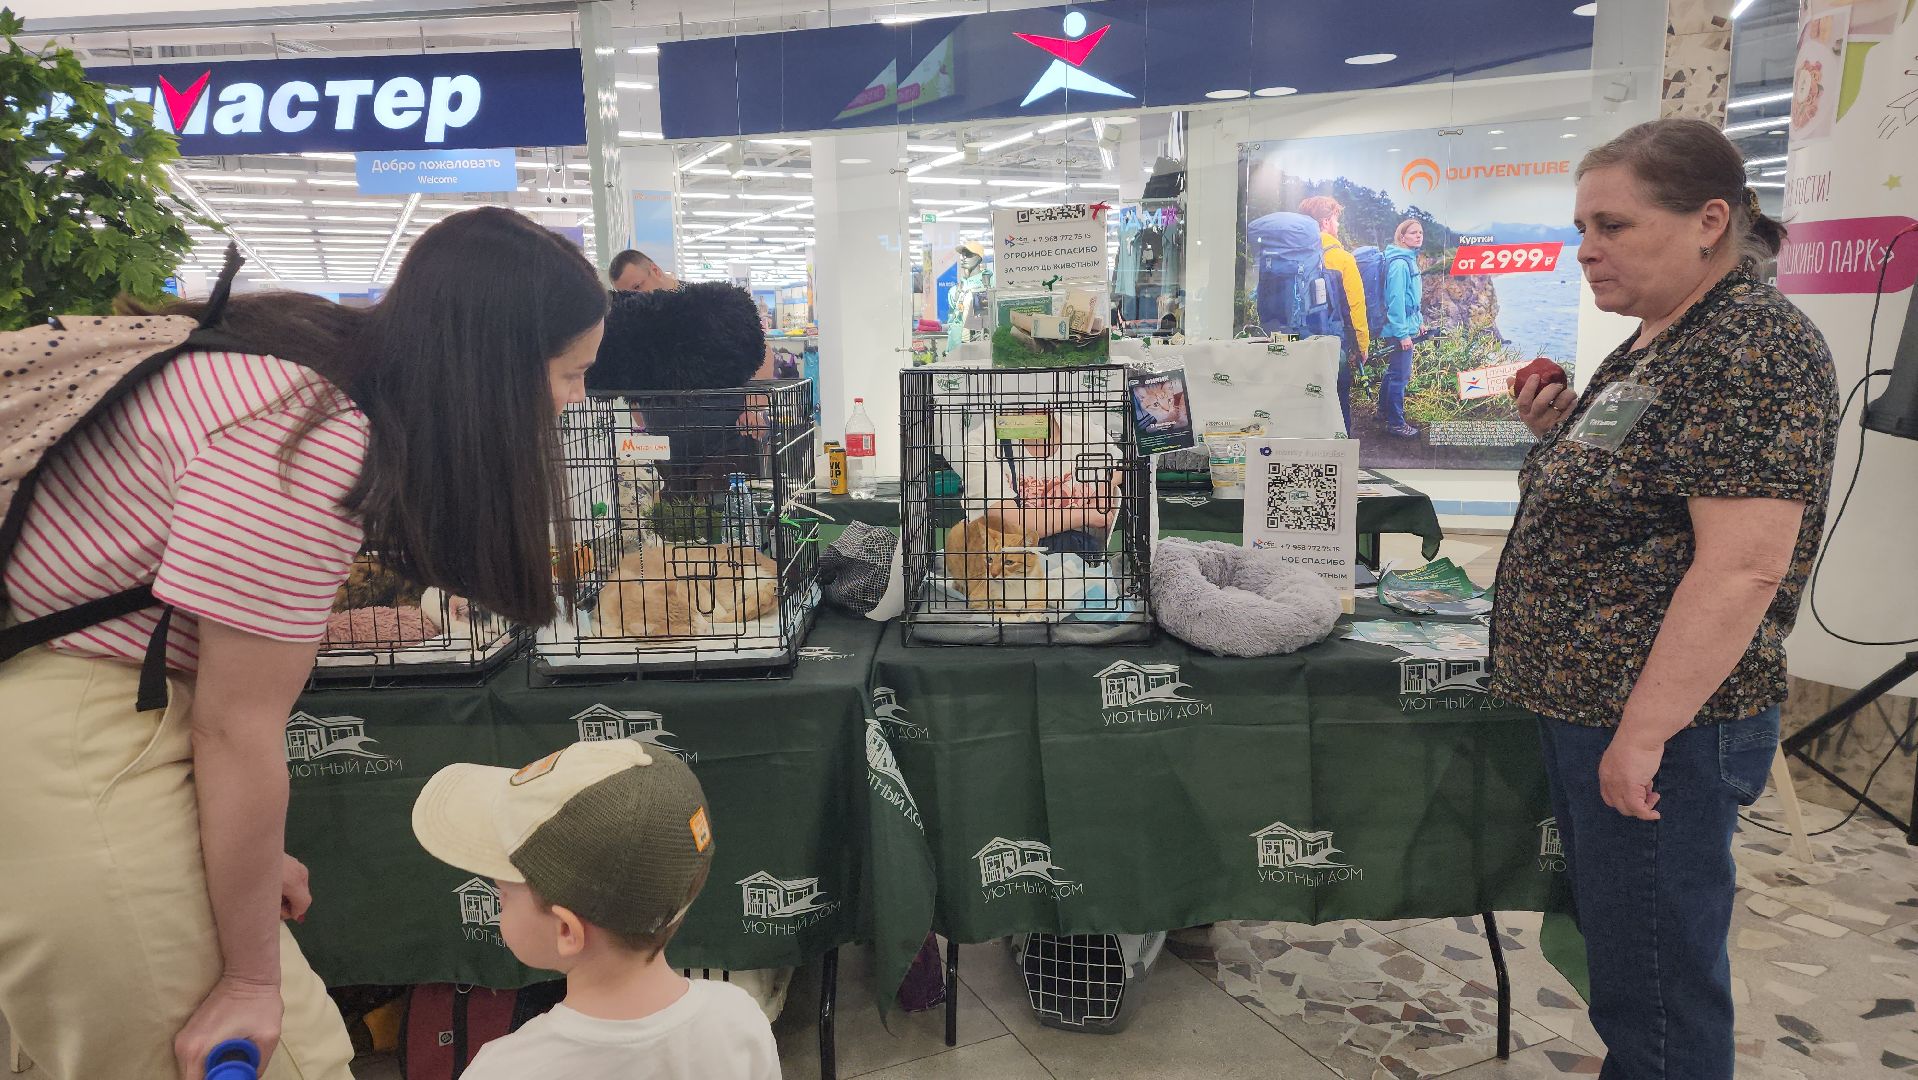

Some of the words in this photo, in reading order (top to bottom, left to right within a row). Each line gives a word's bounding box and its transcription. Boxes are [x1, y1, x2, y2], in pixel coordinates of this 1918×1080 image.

[371, 158, 416, 173] Добро
[419, 158, 501, 170] пожаловать
[1446, 160, 1571, 180] OUTVENTURE
[417, 175, 458, 184] Welcome
[1795, 170, 1832, 205] ГОСТИ!
[1459, 235, 1494, 245] Куртки
[1003, 248, 1053, 260] ОГРОМНОЕ
[1054, 245, 1098, 256] СПАСИБО
[1829, 239, 1895, 274] ПАРК»
[1004, 266, 1014, 274] ЗА
[1053, 260, 1100, 270] ЖИВОТНЫМ
[1301, 557, 1346, 566] СПАСИБО
[1399, 693, 1474, 712] УЮТНЫЙ
[1479, 696, 1505, 711] ДО
[1101, 705, 1173, 727] УЮТНЫЙ
[1176, 703, 1213, 719] ДОМ
[898, 726, 929, 740] ДОМ
[364, 758, 403, 775] ДОМ
[1257, 869, 1324, 888] УЮТНЫЙ
[1327, 867, 1364, 885] ДОМ
[981, 880, 1048, 904] УЮТНЫЙ
[1050, 883, 1084, 901] ДОМ
[741, 914, 807, 936] УЮТНЫЙ
[809, 901, 841, 927] ДОМ
